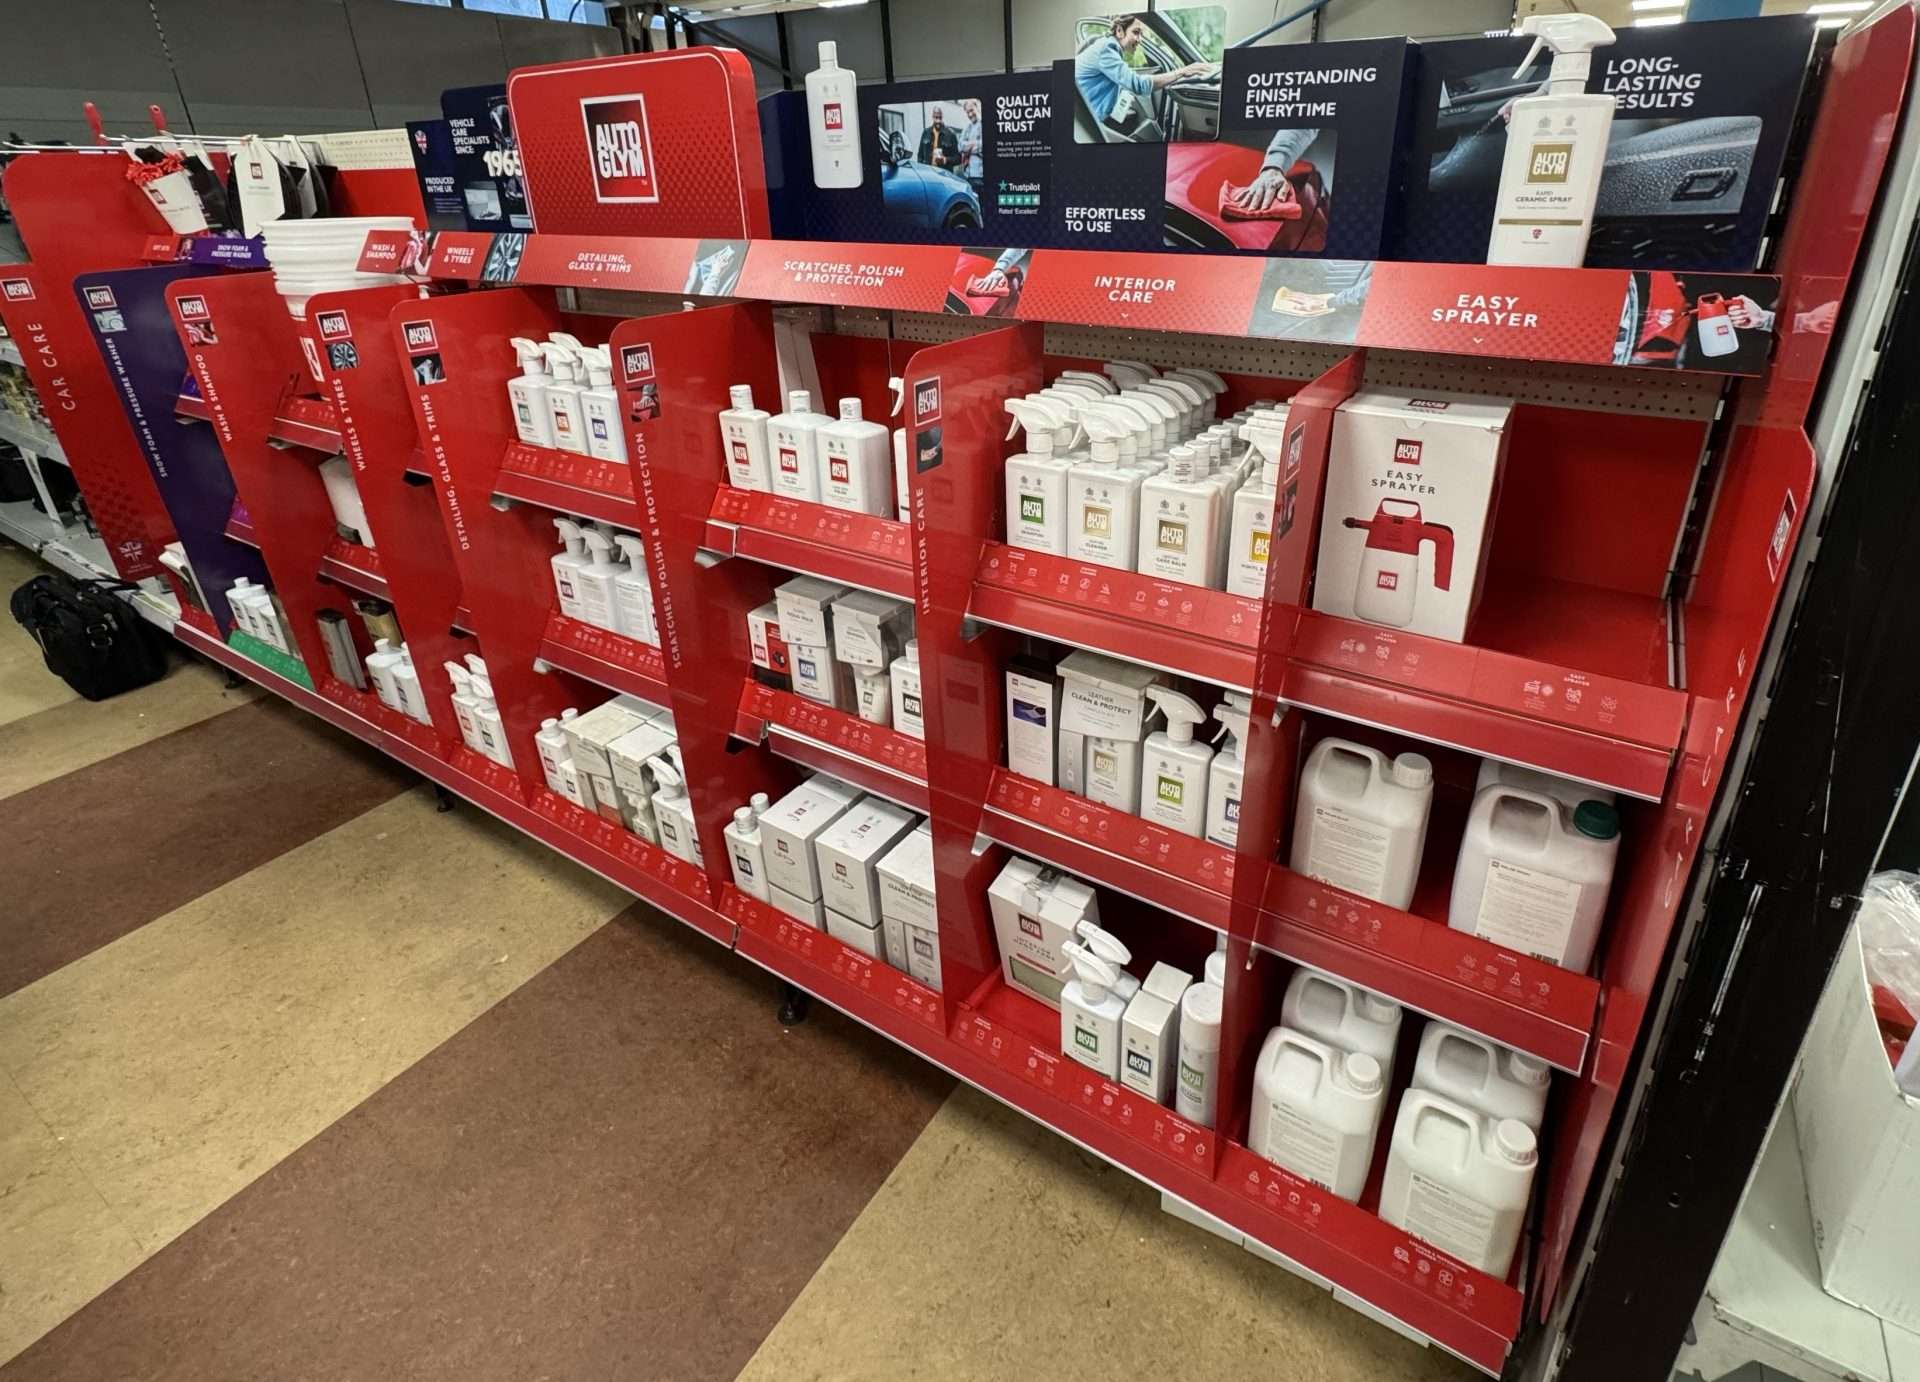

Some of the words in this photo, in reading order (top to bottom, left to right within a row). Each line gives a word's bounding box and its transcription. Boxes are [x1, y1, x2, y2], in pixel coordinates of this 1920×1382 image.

[1606, 56, 1680, 75] LONG-
[1247, 67, 1377, 88] OUTSTANDING
[1603, 73, 1702, 93] LASTING
[996, 93, 1049, 109] QUALITY
[1246, 87, 1301, 103] FINISH
[1614, 92, 1695, 109] ESULTS
[997, 108, 1022, 120] YOU
[1024, 107, 1051, 119] CAN
[1244, 102, 1337, 119] EVERYTIME
[449, 118, 475, 128] VEHICLE
[997, 120, 1035, 132] TRUST
[451, 128, 468, 137] CARE
[596, 121, 641, 151] AUTO
[453, 136, 490, 146] SPECIALISTS
[483, 150, 523, 177] 1965
[598, 148, 646, 178] GLYM
[1536, 151, 1568, 165] AUTO
[1532, 162, 1566, 175] GLYM
[425, 177, 454, 185] PRODUCED
[1008, 183, 1040, 192] Trustpilot
[1065, 207, 1147, 221] EFFORTLESS
[1065, 220, 1084, 233] TO
[1086, 220, 1112, 233] USE
[365, 251, 396, 259] SHAMPOO
[447, 247, 475, 256] WHEELS
[577, 252, 626, 264] DETAILING,
[450, 256, 472, 264] TYRES
[568, 262, 595, 272] GLASS
[596, 263, 602, 272] &
[605, 263, 632, 273] TRIMS
[783, 260, 854, 275] SCRATCHES,
[858, 264, 905, 277] POLISH
[794, 273, 801, 282] &
[806, 273, 884, 287] PROTECTION
[1094, 275, 1176, 292] INTERIOR
[1108, 290, 1153, 304] CARE
[1457, 294, 1520, 310] EASY
[1431, 308, 1538, 328] SPRAYER
[27, 322, 57, 368] CARE
[626, 351, 648, 364] AUTO
[627, 361, 651, 374] GLYM
[52, 377, 76, 411] CAR
[333, 378, 349, 413] TYRES
[917, 388, 937, 402] AUTO
[421, 394, 437, 431] TRIMS
[918, 400, 938, 415] GLYM
[347, 427, 367, 471] WHEELS
[434, 446, 451, 482] GLASS
[634, 432, 659, 524] PROTECTION
[1387, 470, 1424, 481] EASY
[1371, 478, 1436, 495] SPRAYER
[915, 487, 925, 532] CARE
[446, 485, 470, 551] DETAILING,
[654, 542, 668, 589] POLISH
[917, 536, 929, 615] INTERIOR
[661, 592, 681, 669] SCRATCHES,
[1071, 691, 1093, 705] CLEAN
[1093, 699, 1099, 707] &
[1100, 701, 1132, 716] PROTECT
